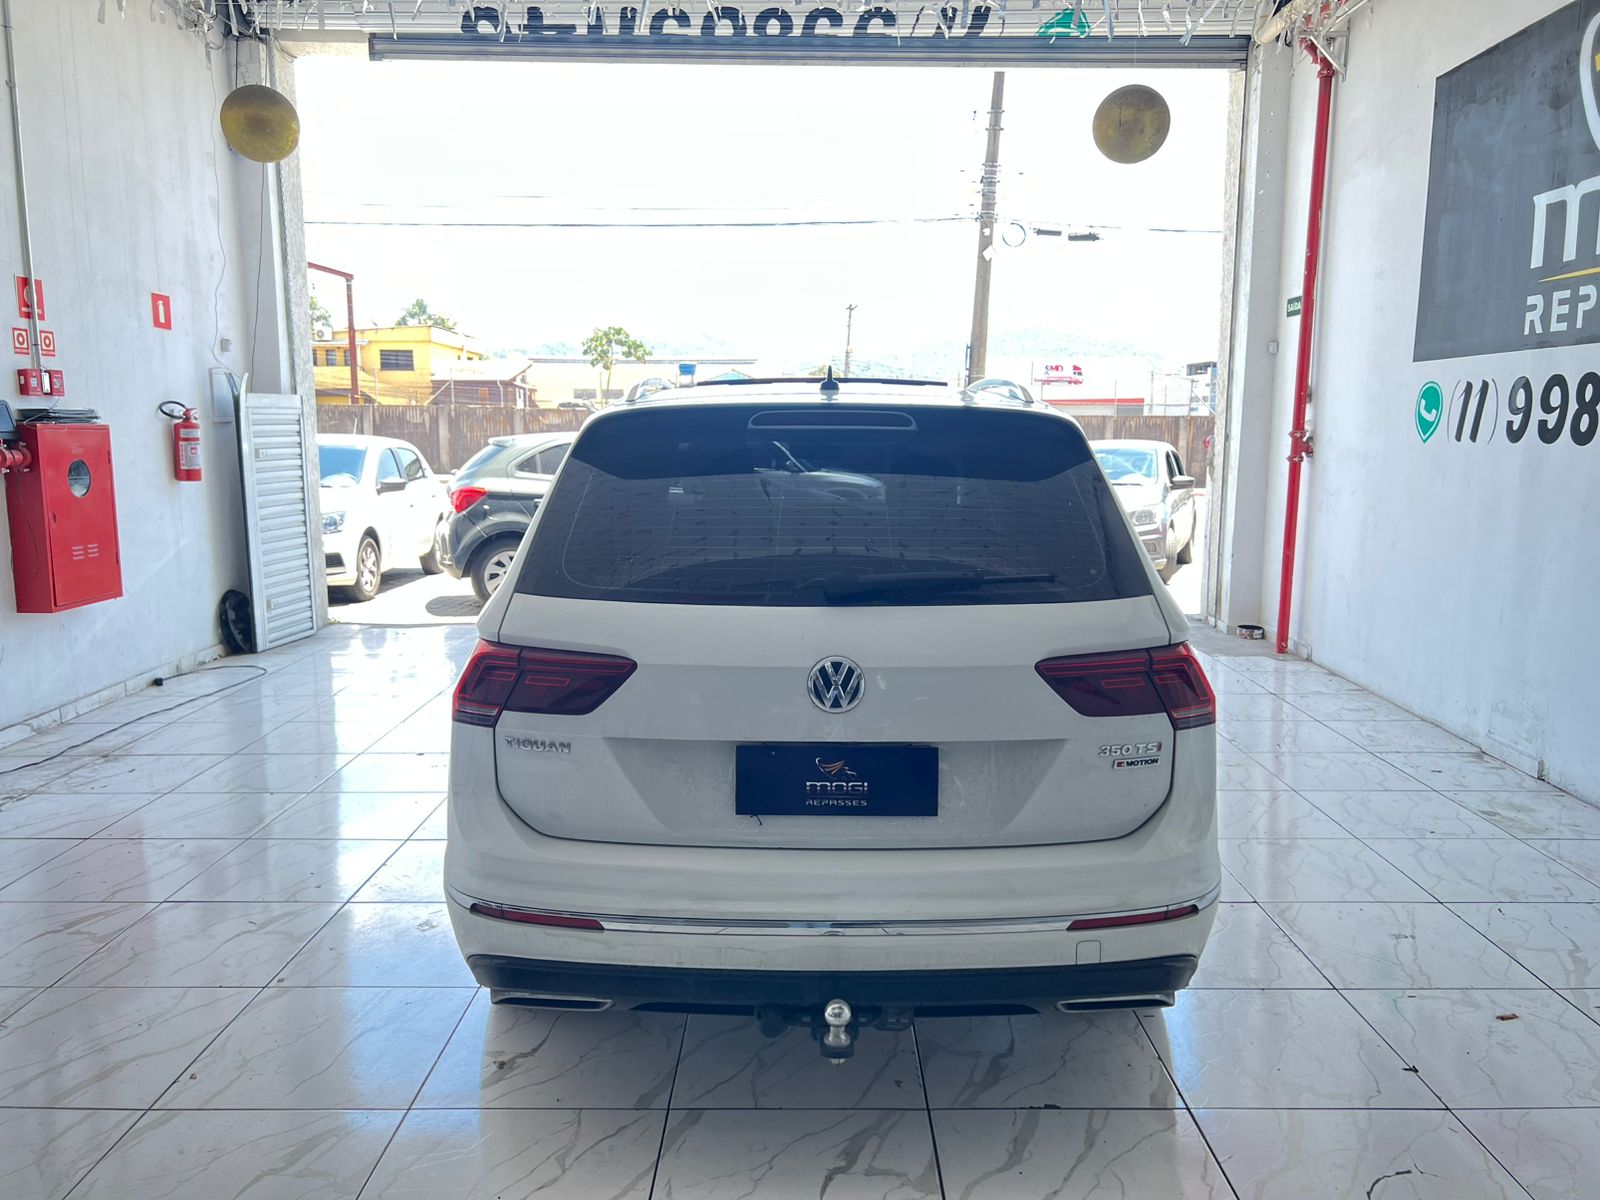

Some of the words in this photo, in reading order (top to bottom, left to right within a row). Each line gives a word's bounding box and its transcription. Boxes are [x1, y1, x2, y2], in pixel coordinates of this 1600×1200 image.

[1524, 284, 1597, 336] REP
[505, 735, 572, 753] TIGUAN
[1099, 744, 1133, 757] 350
[806, 781, 868, 794] MOGI
[806, 799, 867, 807] REPASSES
